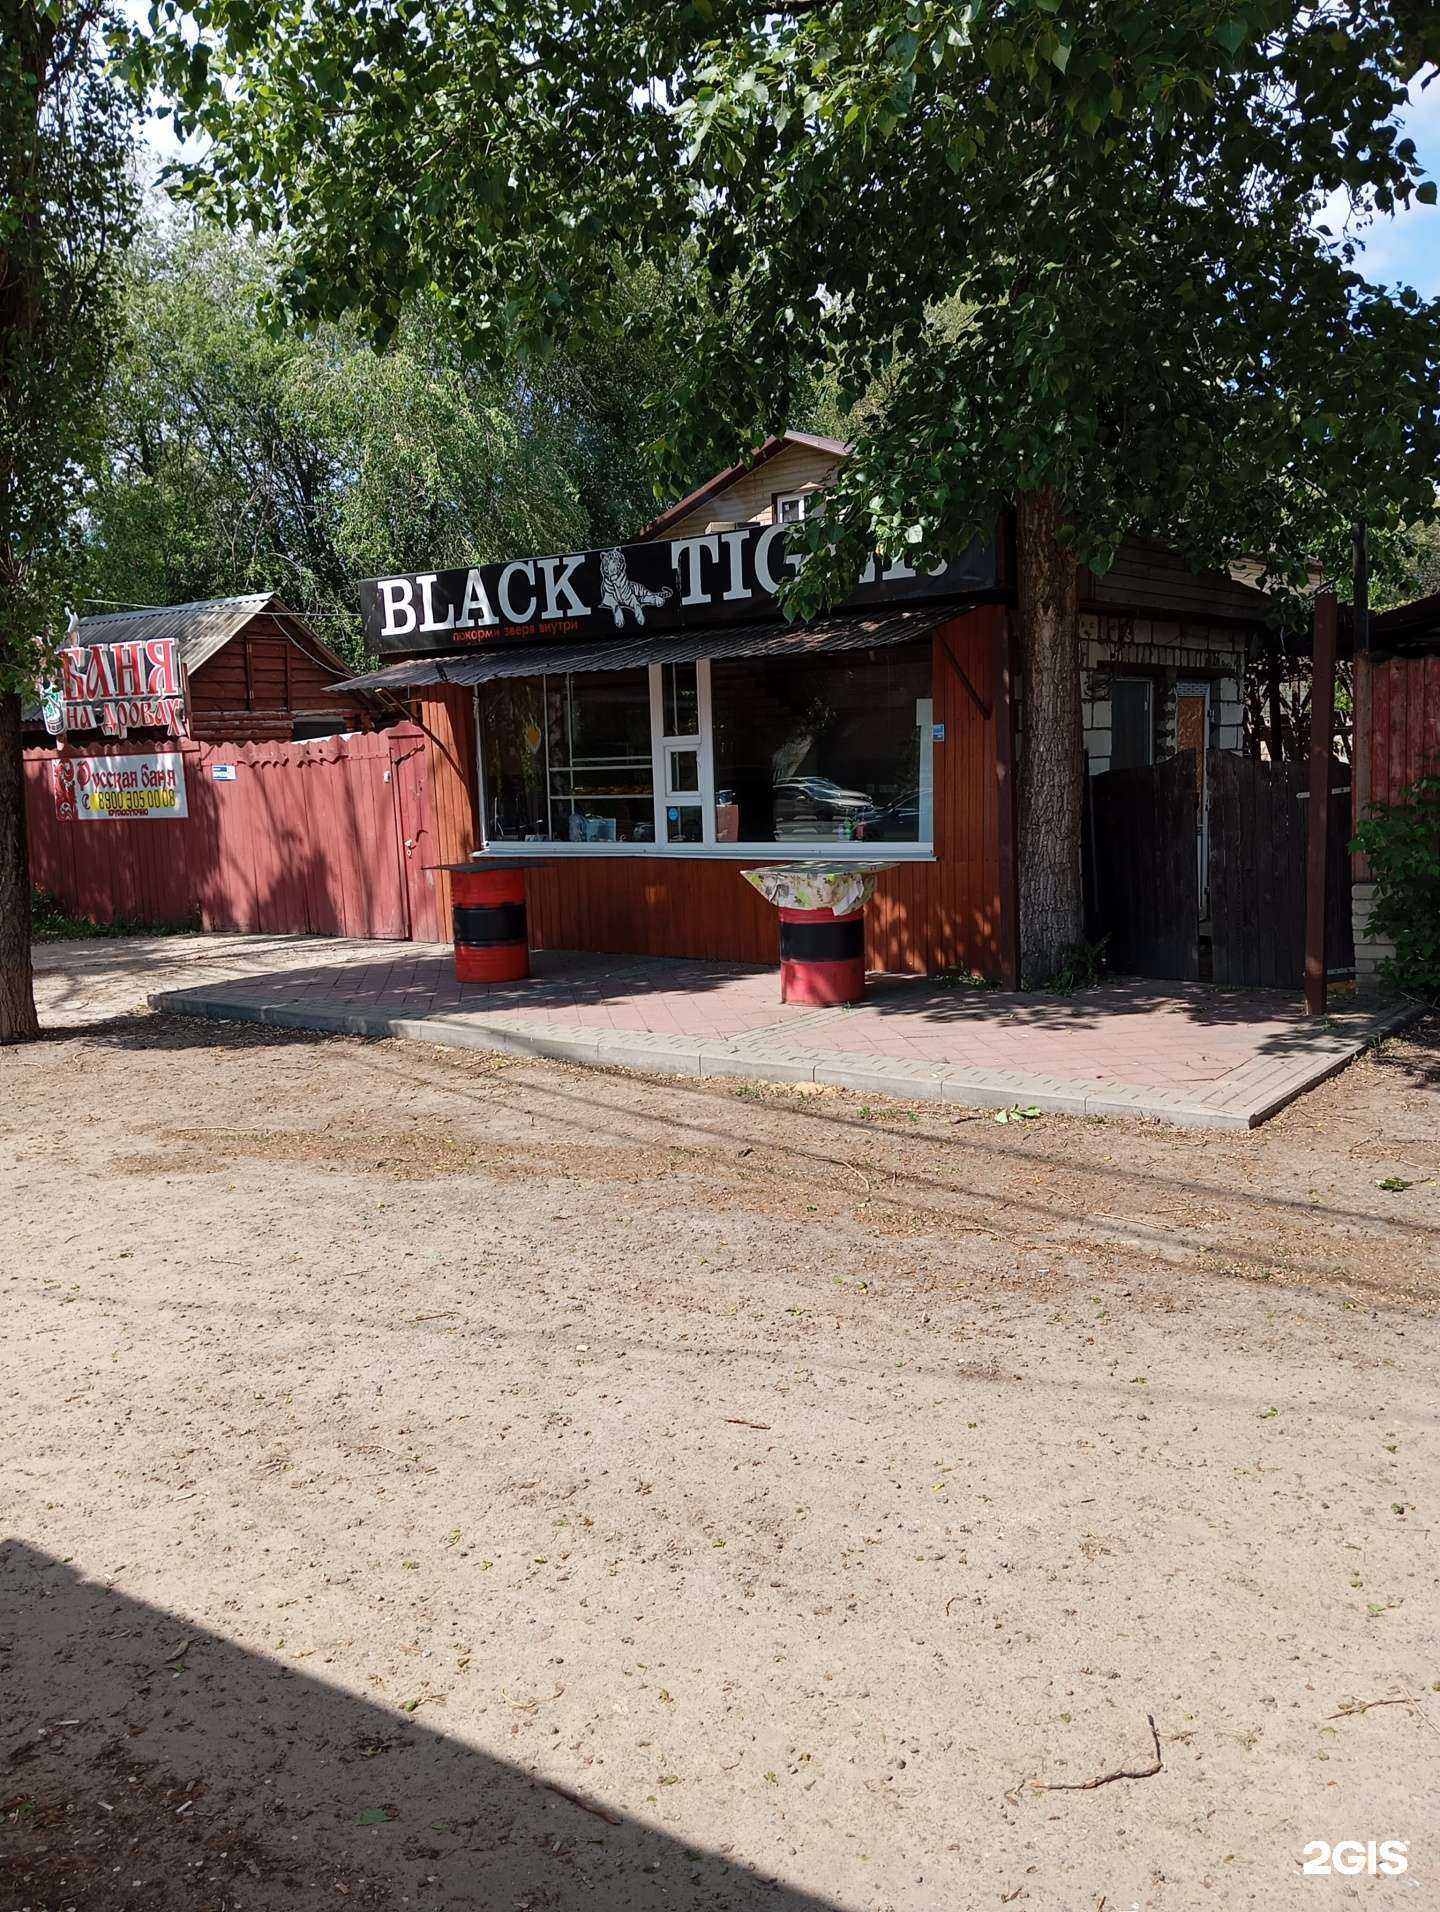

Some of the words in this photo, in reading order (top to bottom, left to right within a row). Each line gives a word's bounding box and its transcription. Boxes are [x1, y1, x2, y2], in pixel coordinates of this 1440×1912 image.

[377, 555, 592, 636] BLACK
[671, 513, 949, 606] TIG
[540, 620, 578, 634] внутри
[60, 638, 179, 702] БАНЯ
[77, 761, 138, 792] Русская
[141, 764, 176, 790] баня
[98, 791, 123, 810] 8900
[126, 790, 145, 809] 305
